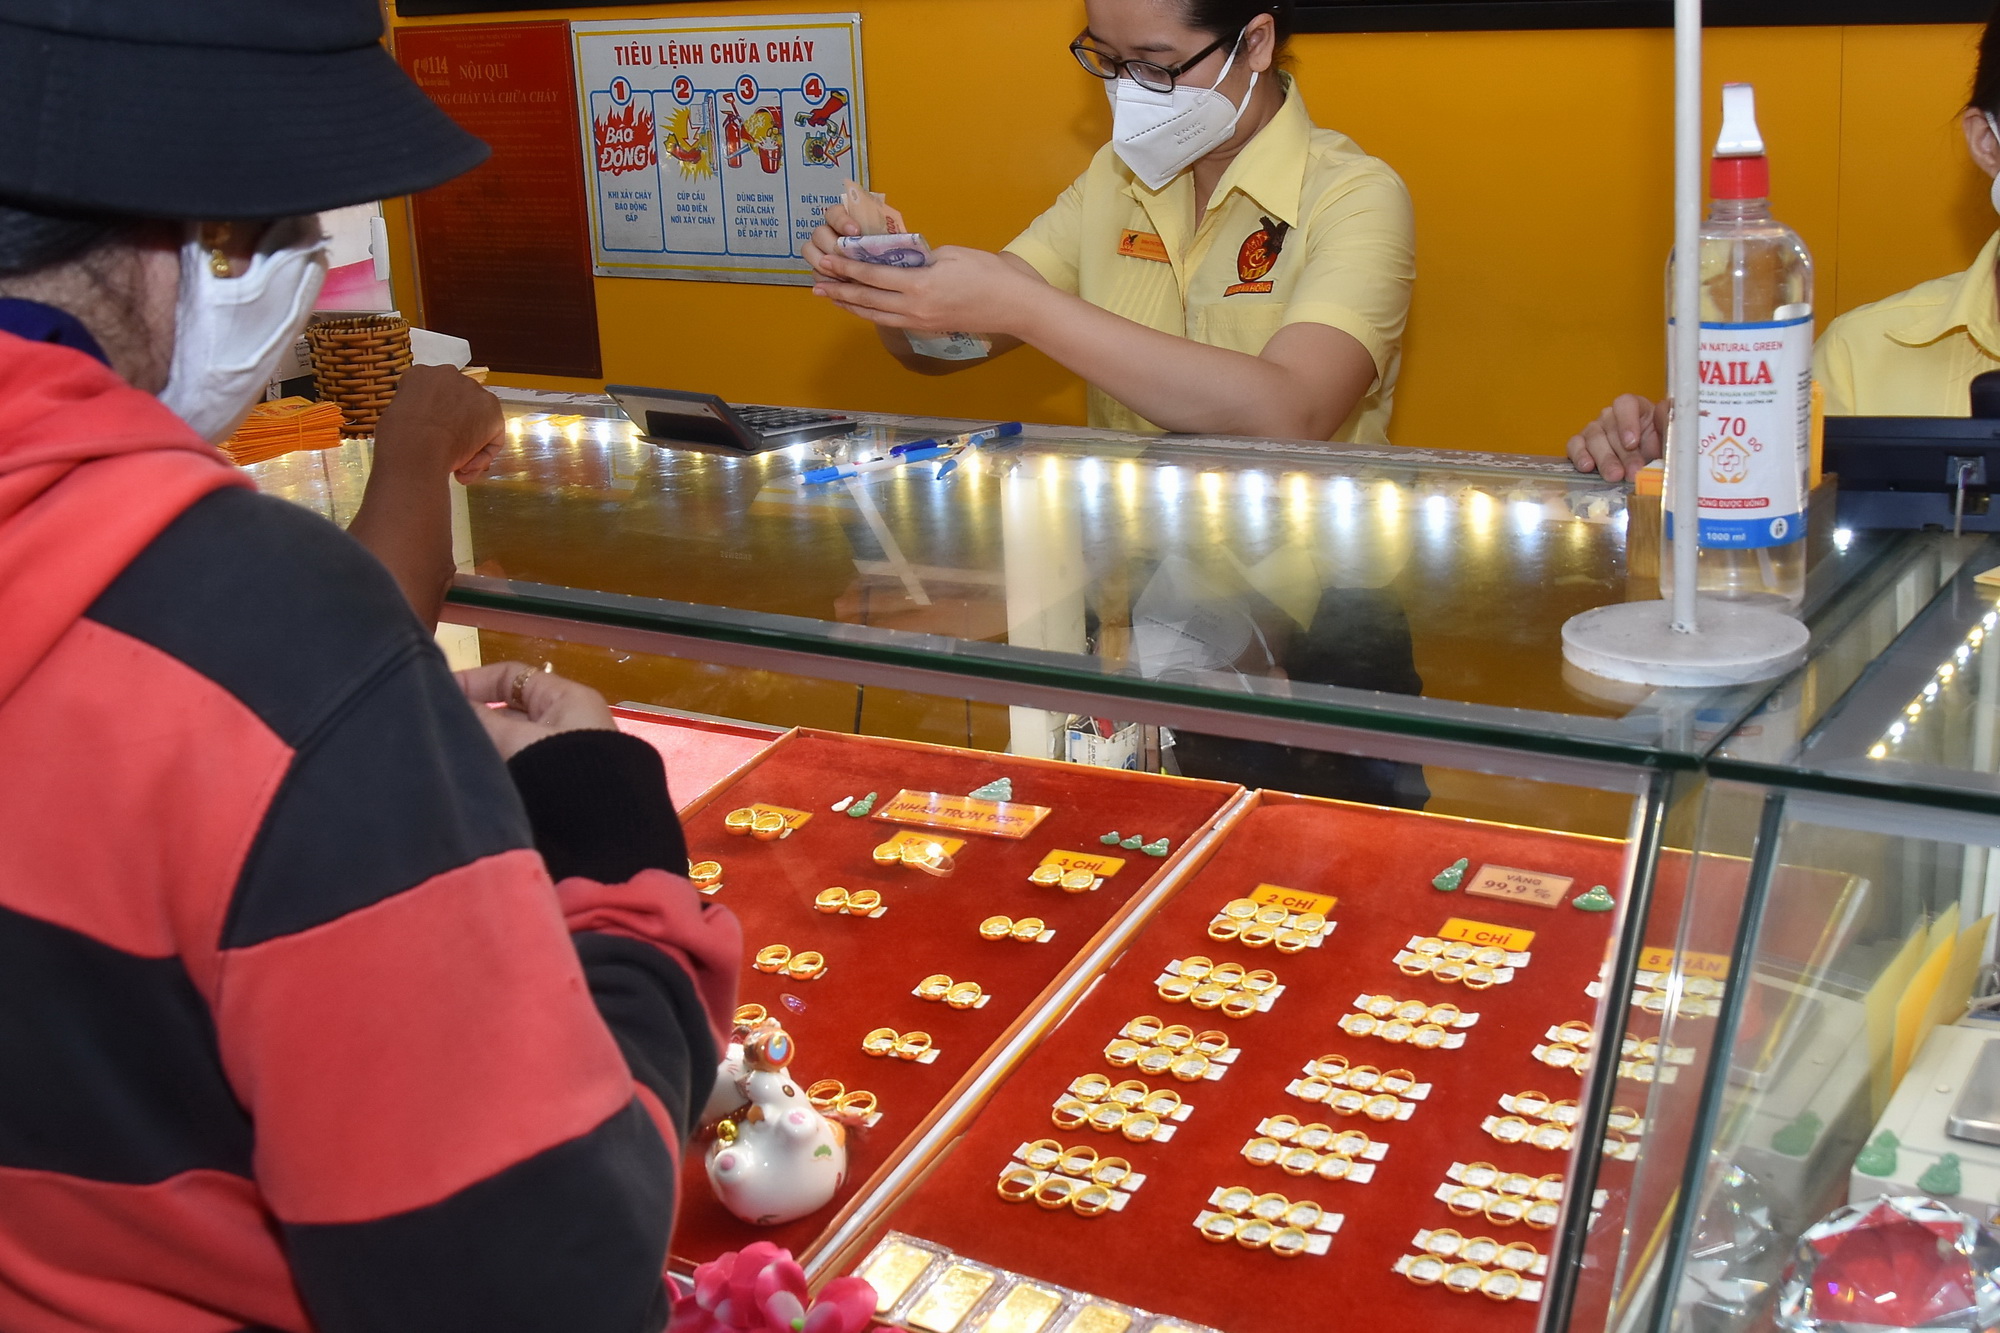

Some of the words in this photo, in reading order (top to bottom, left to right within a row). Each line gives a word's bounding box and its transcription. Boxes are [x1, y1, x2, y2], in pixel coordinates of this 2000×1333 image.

[614, 41, 653, 66] TIÊU
[659, 40, 704, 69] LỆNH
[710, 37, 761, 64] CHỮA
[766, 35, 814, 63] CHÁY
[428, 55, 449, 75] 114
[459, 60, 482, 82] NỘI
[485, 63, 509, 82] QUI
[427, 89, 451, 105] ÒNG
[452, 90, 481, 105] CHÁY
[482, 90, 496, 104] VÀ
[530, 88, 559, 103] CHÁY
[614, 81, 625, 100] 1
[675, 78, 690, 99] 2
[740, 78, 754, 99] 3
[805, 78, 822, 98] 4
[605, 124, 634, 145] BÁO
[600, 144, 646, 173] ĐỘNG
[608, 190, 619, 199] KHI
[736, 191, 756, 202] DÙNG
[757, 192, 774, 202] BÌNH
[801, 193, 818, 204] ĐIỆN
[629, 202, 648, 212] ĐỘNG
[750, 215, 759, 226] VÀ
[761, 215, 779, 227] NƯỚC
[796, 217, 809, 229] ĐỘI
[810, 217, 828, 228] CHỮ
[1709, 342, 1751, 352] NATURAL
[1753, 340, 1783, 352] GREEN
[1718, 416, 1746, 437] 70
[1706, 532, 1730, 541] 1000
[1732, 532, 1746, 541] ml
[1058, 858, 1070, 867] 3
[1073, 860, 1107, 872] CHỈ
[1266, 894, 1279, 904] 2
[1282, 898, 1318, 911] CHỈ
[1460, 928, 1469, 938] 1
[1475, 931, 1513, 945] CHỈ
[1648, 954, 1662, 965] 5
